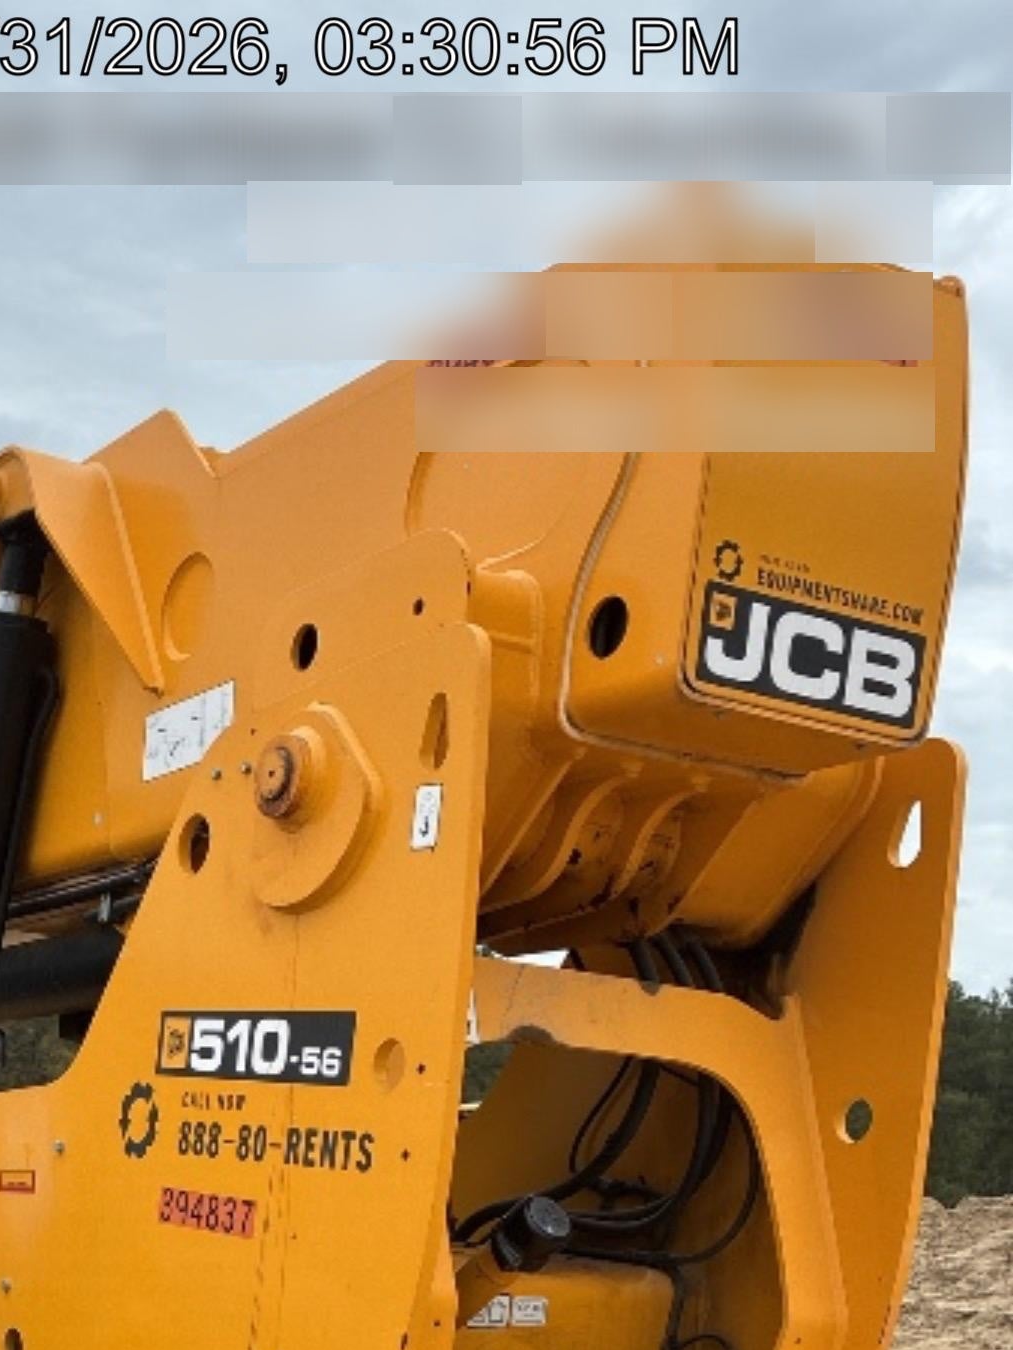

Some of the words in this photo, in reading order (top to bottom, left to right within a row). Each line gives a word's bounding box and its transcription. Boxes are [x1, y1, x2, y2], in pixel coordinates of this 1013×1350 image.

[756, 568, 925, 626] EQUIPMENTSHARE.COM
[704, 601, 917, 719] JCB
[177, 1120, 375, 1174] 888-80-RENTS
[159, 1186, 257, 1235] 394837
